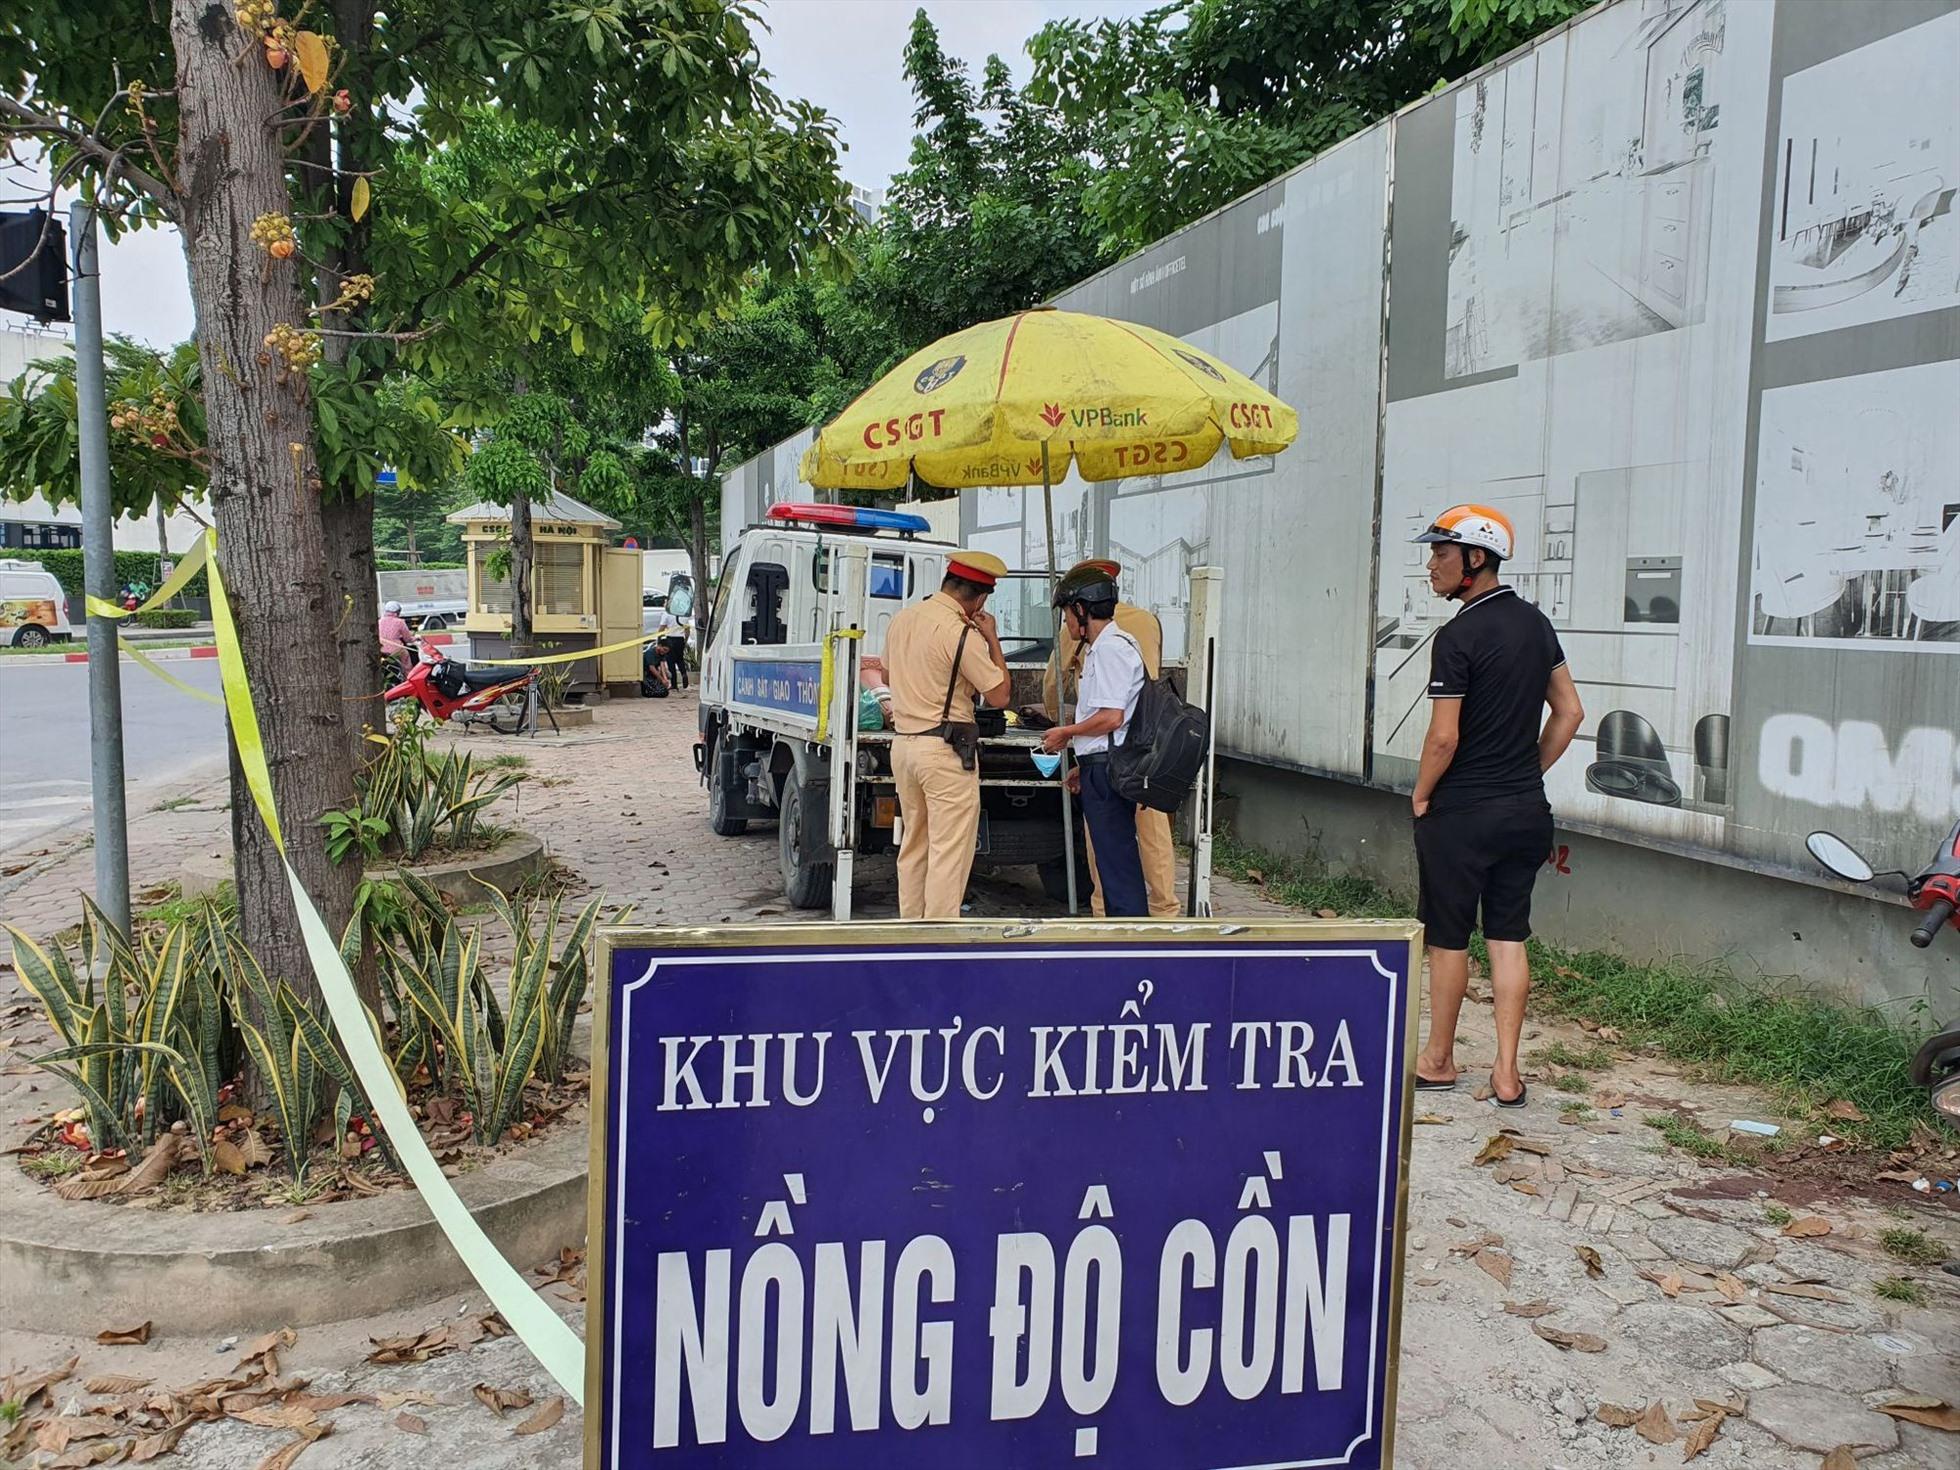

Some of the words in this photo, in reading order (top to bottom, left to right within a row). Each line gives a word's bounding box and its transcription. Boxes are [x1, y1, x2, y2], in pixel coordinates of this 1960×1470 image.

[863, 408, 946, 450] CSGT
[1071, 407, 1148, 427] VPBank
[1230, 402, 1273, 429] CSGT
[773, 680, 790, 702] GIAO
[656, 1030, 833, 1112] KHU
[851, 1014, 1005, 1124] VỰC
[1027, 979, 1212, 1099] KIỂM
[1229, 1018, 1364, 1090] TRA
[653, 1173, 957, 1449] NỒNG
[989, 1184, 1123, 1457] ĐỘ
[1155, 1150, 1352, 1407] CỒN
